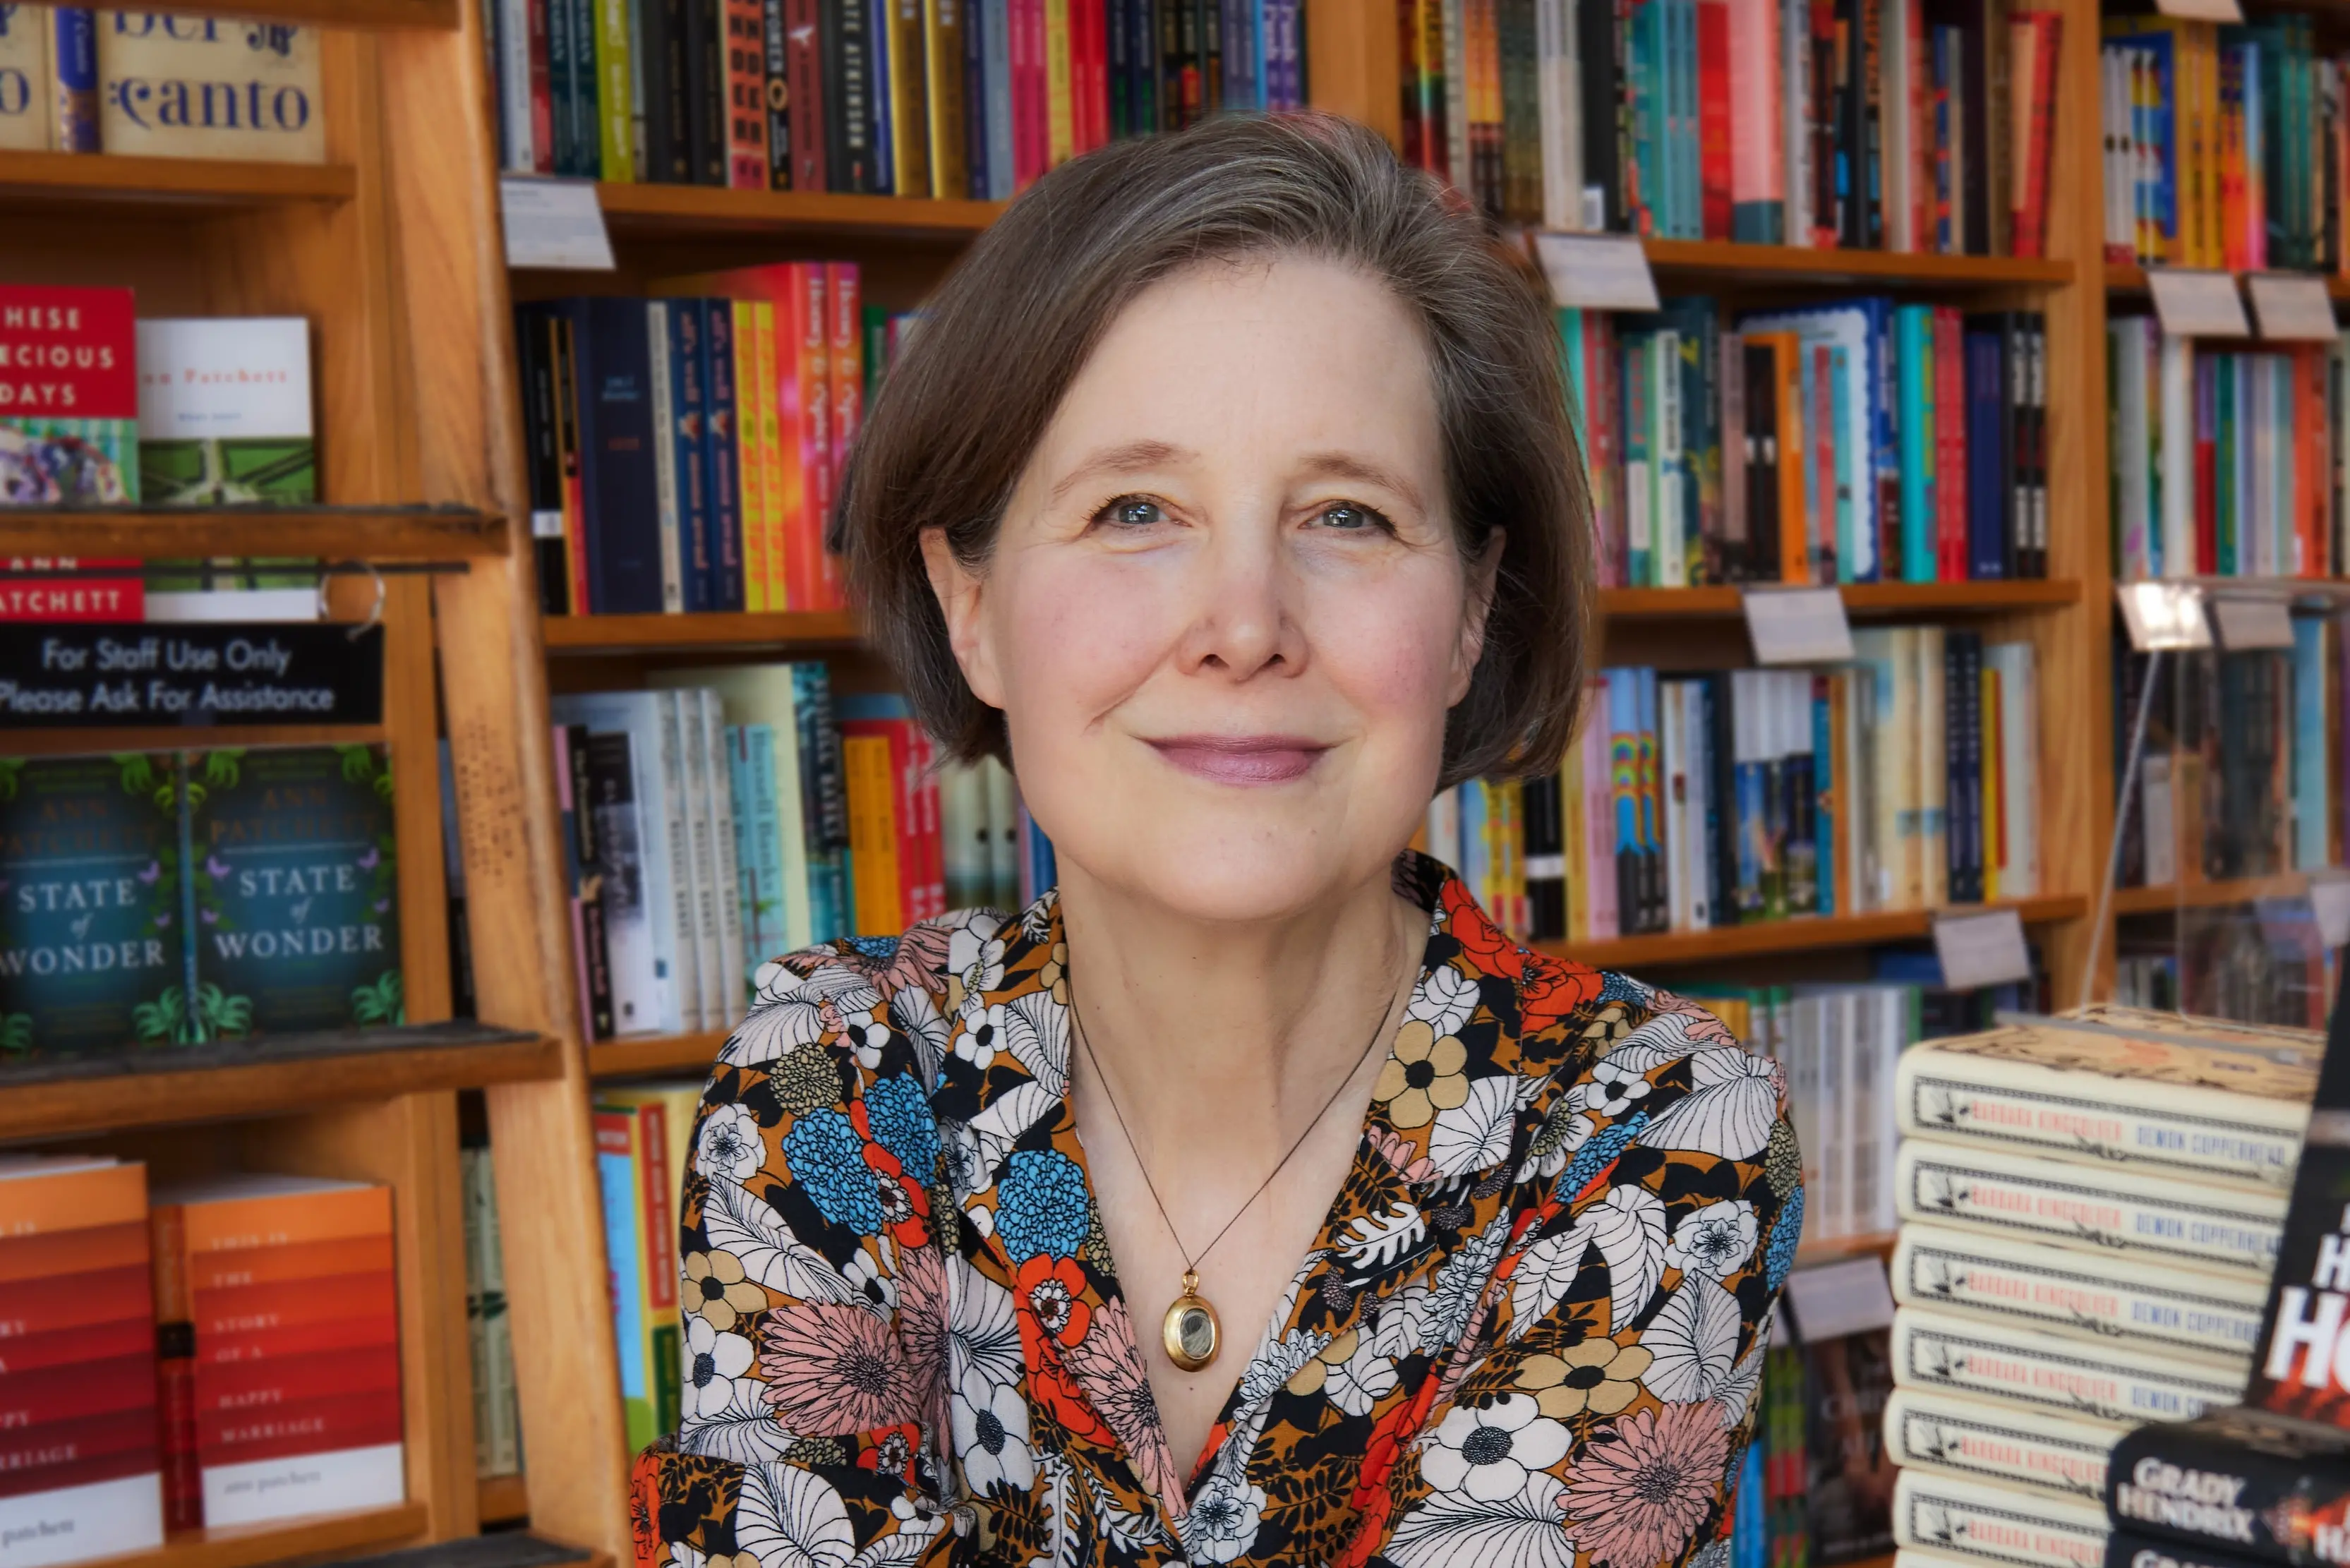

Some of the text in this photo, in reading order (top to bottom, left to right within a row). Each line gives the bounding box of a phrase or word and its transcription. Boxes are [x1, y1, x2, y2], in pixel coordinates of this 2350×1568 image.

[844, 42, 865, 149] ATKINSON
[42, 639, 291, 677] For Staff Use Only
[0, 682, 335, 713] Please Ask For Assistance
[18, 876, 138, 914] STATE
[239, 864, 356, 898] STATE
[71, 912, 95, 939] of
[289, 896, 313, 924] of
[0, 940, 167, 977] WONDER
[215, 924, 386, 961] WONDER
[1971, 1099, 2286, 1166] BARBARA KINGSOLVER DEMON COPPERHEAD
[1970, 1184, 2032, 1214] BARBARA
[2037, 1192, 2122, 1230] KINGSOLVER
[2135, 1211, 2185, 1239] DEMON
[212, 1231, 289, 1252] THIS IS
[214, 1271, 254, 1289] THE
[1967, 1270, 2030, 1301] BARBARA
[2034, 1279, 2119, 1319] KINGSOLVER
[2131, 1300, 2182, 1326] DEMON
[214, 1313, 282, 1335] STORY
[215, 1345, 265, 1365] OF A
[218, 1389, 284, 1410] HAPPY
[1966, 1354, 2182, 1413] BARBARA KINGSOLVER DEMON
[221, 1418, 327, 1445] MARRIAGE
[1960, 1436, 2108, 1481] BARBARA KINGSOLVE
[2133, 1456, 2247, 1504] GRADY
[2117, 1483, 2256, 1544] HENDRIX
[1967, 1517, 2030, 1549] BARBARA
